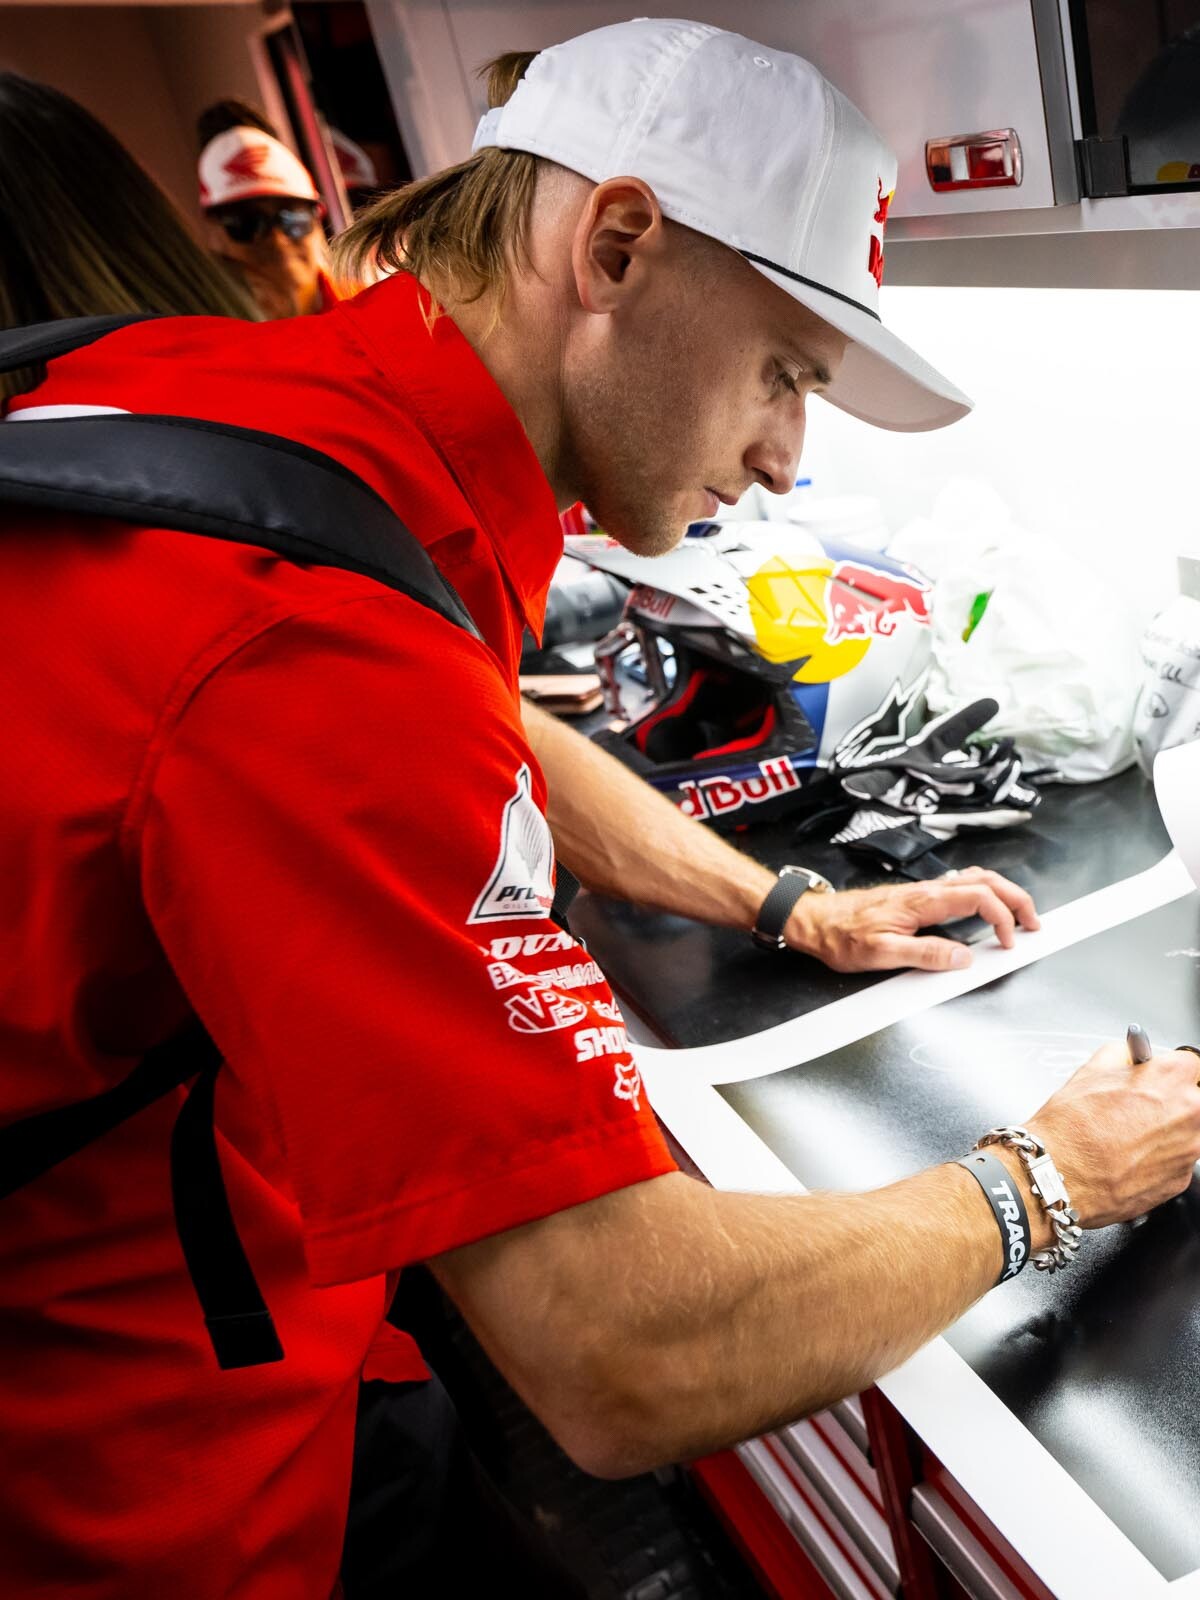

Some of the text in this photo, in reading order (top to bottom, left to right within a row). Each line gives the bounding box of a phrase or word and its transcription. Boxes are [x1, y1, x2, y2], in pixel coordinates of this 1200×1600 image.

[702, 757, 799, 812] Bull
[490, 931, 580, 960] DUN
[990, 1180, 1027, 1280] TRACK
